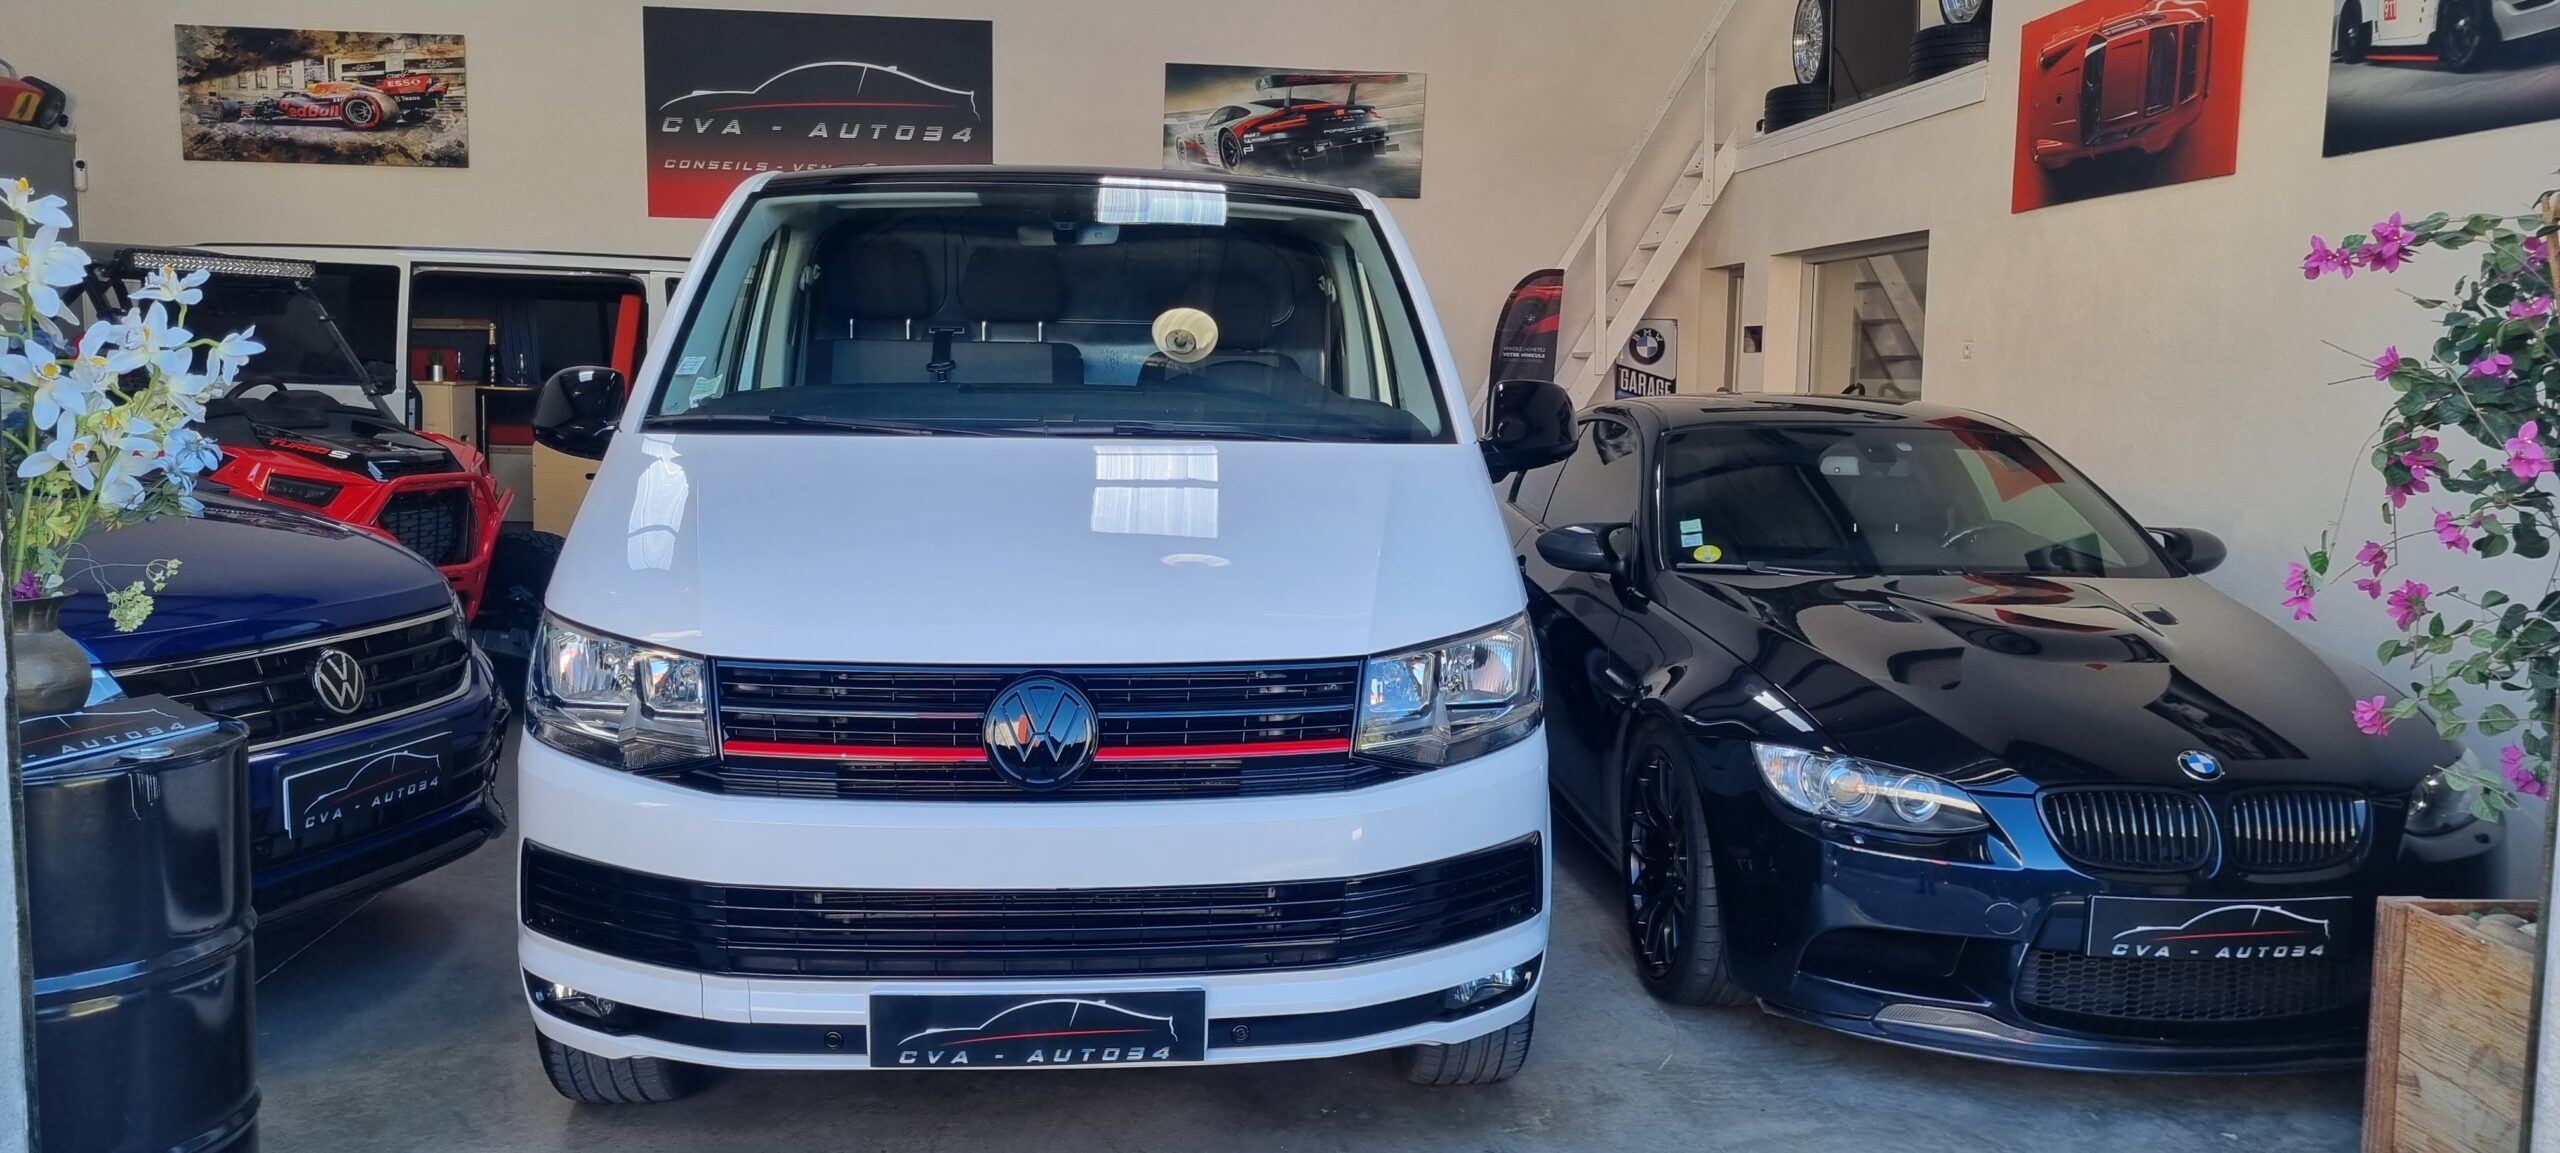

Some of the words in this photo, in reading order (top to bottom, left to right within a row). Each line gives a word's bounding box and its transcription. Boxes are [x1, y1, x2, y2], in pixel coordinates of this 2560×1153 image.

[661, 116, 742, 135] CVA
[808, 122, 973, 143] AUTO34
[664, 159, 769, 172] CONSEILS
[1632, 329, 1664, 342] BMW
[1620, 368, 1672, 397] GARAGE
[270, 438, 331, 454] TURBO
[328, 450, 351, 459] S
[61, 722, 186, 754] AUTO34
[305, 807, 343, 829] CVA
[371, 776, 439, 808] AUTO34
[2111, 943, 2171, 958] CVA
[2214, 945, 2325, 959] AUTO34
[898, 1050, 969, 1065] CVA
[1026, 1046, 1171, 1063] AUTO34
